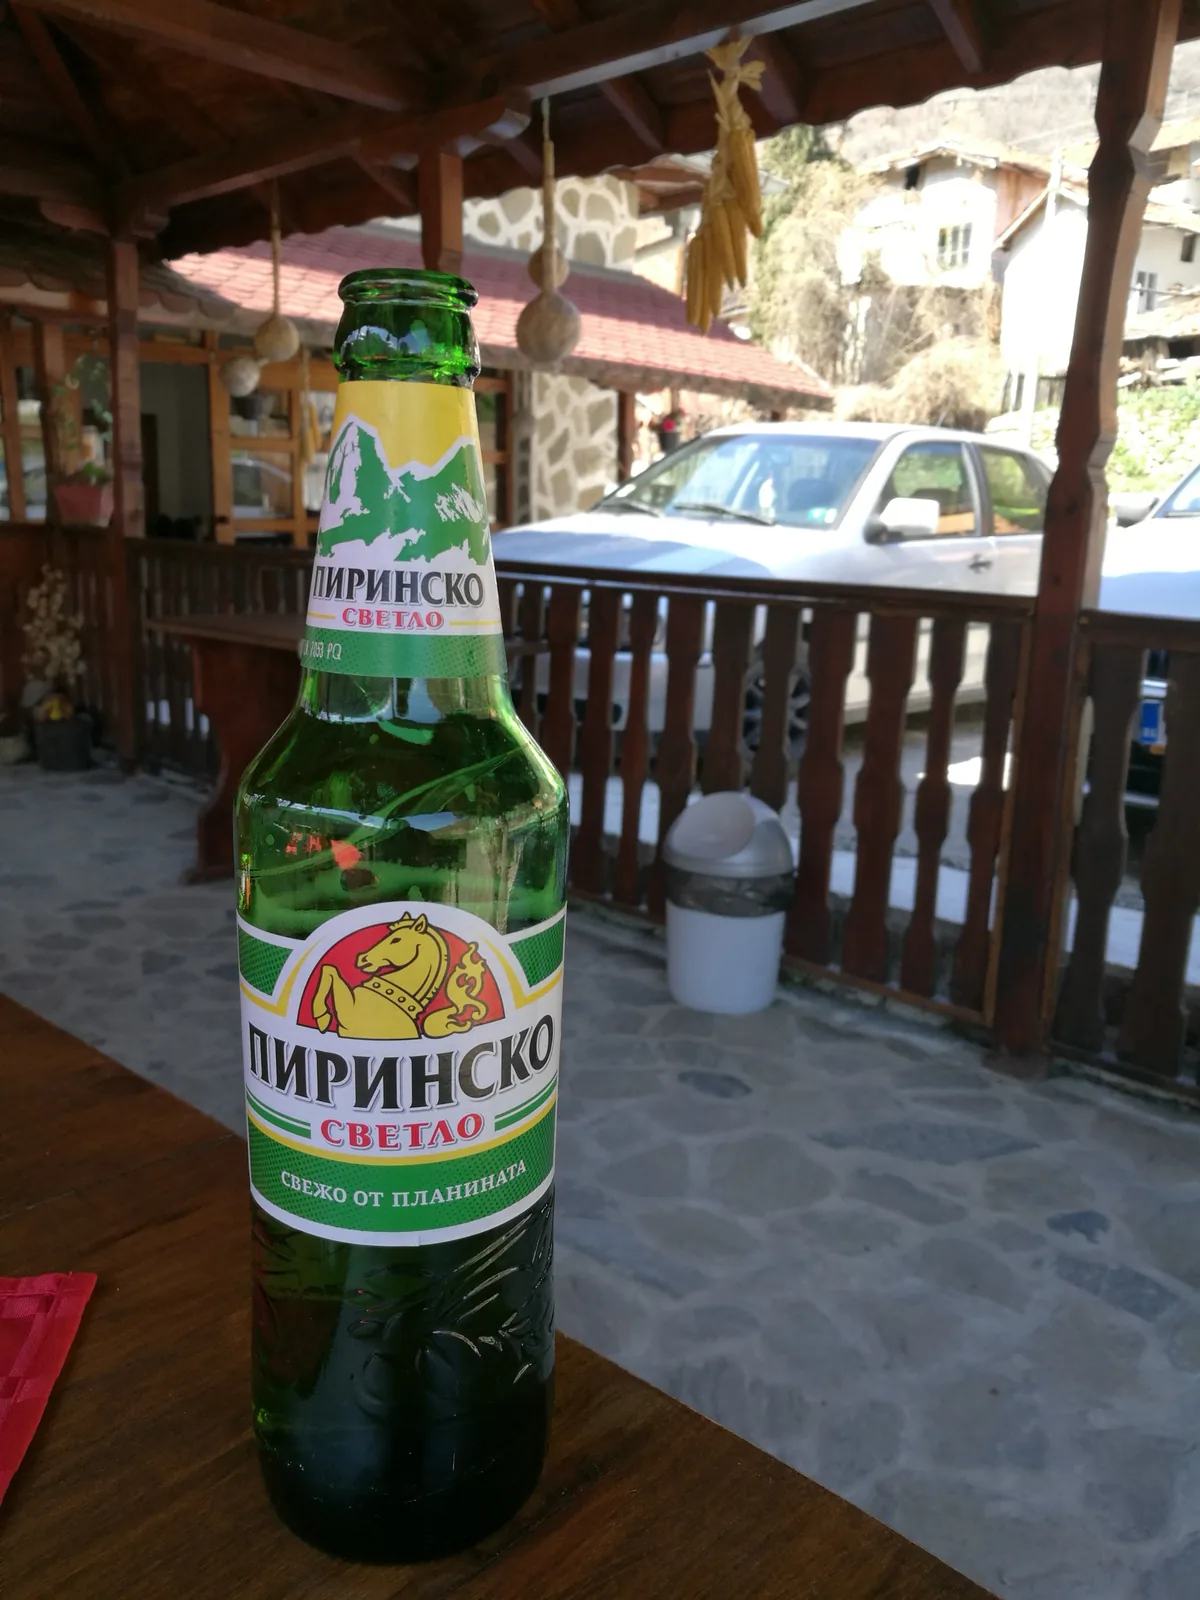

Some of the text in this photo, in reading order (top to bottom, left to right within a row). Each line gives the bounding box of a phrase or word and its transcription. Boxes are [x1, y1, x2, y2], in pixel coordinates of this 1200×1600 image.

[312, 565, 485, 607] ПИРИНСКО
[341, 607, 444, 630] СВЕТЛО
[248, 1014, 554, 1110] ПИРИНСКО
[320, 1113, 484, 1149] СВЕТЛО
[281, 1159, 527, 1207] СВЕЖО ОТ ПЛАНИНАТА
